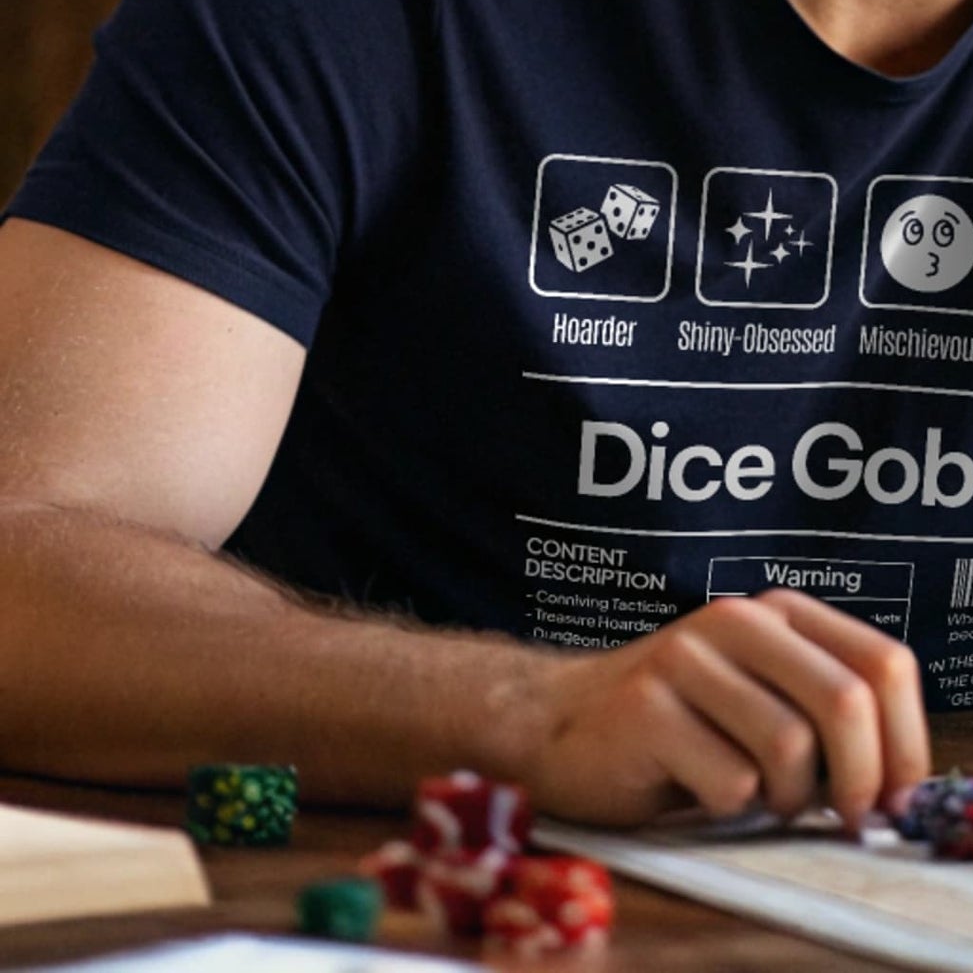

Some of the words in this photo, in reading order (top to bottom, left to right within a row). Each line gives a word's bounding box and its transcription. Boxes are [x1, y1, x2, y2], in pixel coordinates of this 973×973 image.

[553, 313, 637, 347] Hoarder
[677, 321, 836, 356] Shiny-Obsessed
[577, 420, 775, 501] Dice
[526, 537, 628, 567] CONTENT
[524, 558, 667, 591] DESCRIPTION
[764, 562, 862, 593] Warning
[535, 589, 609, 613] Conniving
[612, 598, 678, 614] Tactician
[535, 608, 596, 627] Treasure
[598, 615, 660, 633] Hoarder
[938, 673, 969, 689] THE
